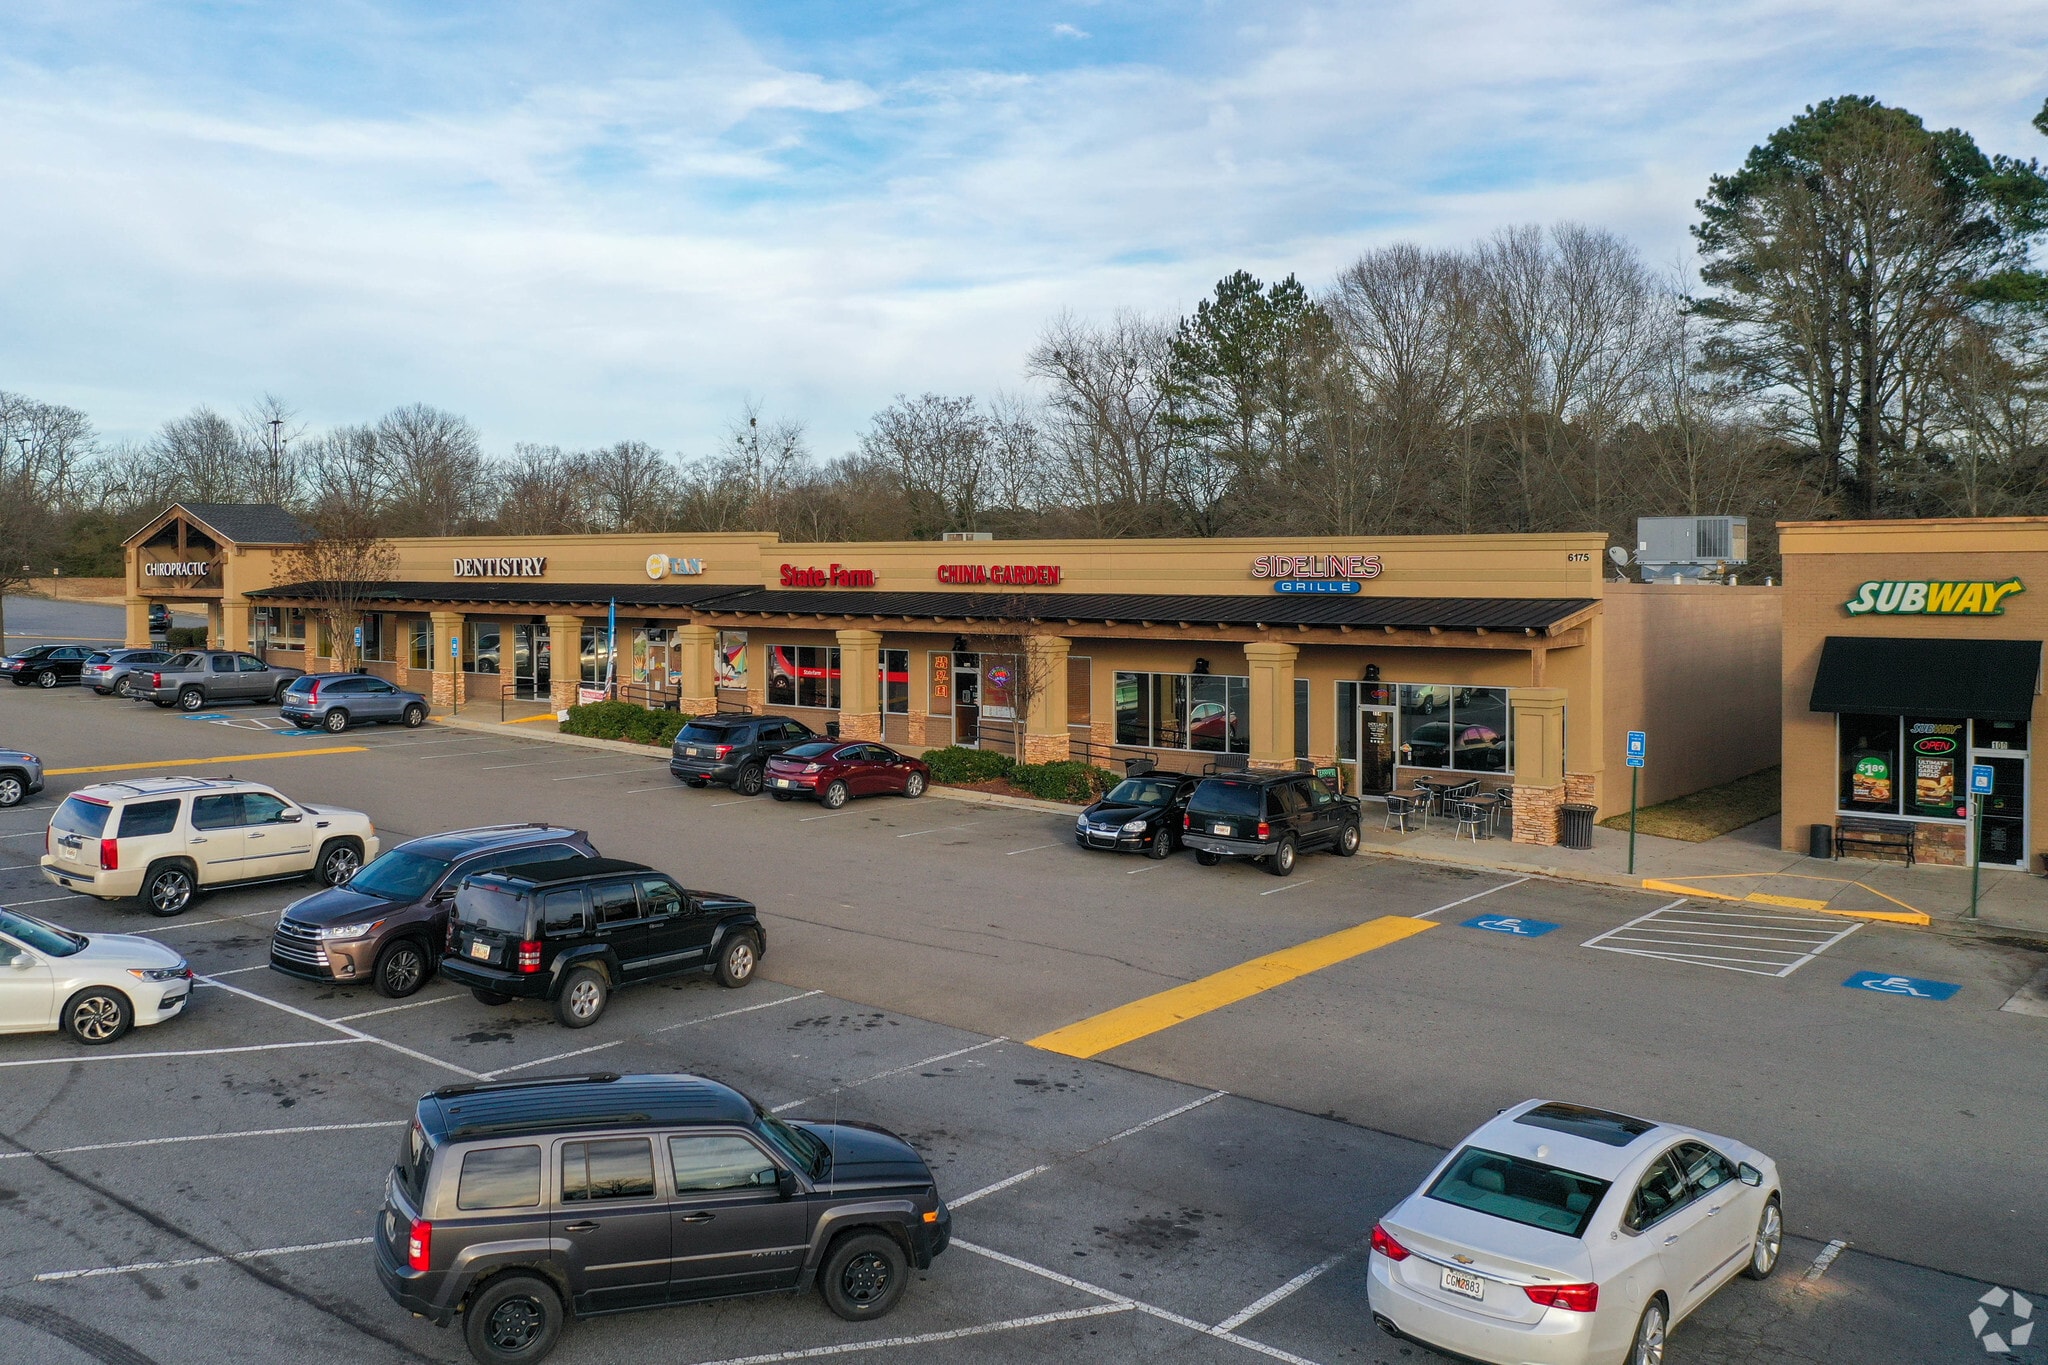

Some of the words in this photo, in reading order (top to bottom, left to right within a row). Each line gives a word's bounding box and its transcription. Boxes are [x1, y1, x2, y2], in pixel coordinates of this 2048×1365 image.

[1568, 553, 1590, 562] 6175
[145, 561, 208, 576] CHIROPRACTIC
[453, 557, 544, 577] DENTISTRY
[669, 558, 703, 575] TAN
[1252, 555, 1382, 578] SIDELINES
[780, 563, 826, 587] State
[829, 563, 875, 586] Farm
[937, 565, 987, 584] CHINA
[990, 565, 1060, 585] GARDEN
[1281, 582, 1351, 592] GRILLE
[1847, 579, 2022, 613] SUBWAY
[1910, 723, 1962, 735] SUBWAY
[1919, 740, 1951, 751] OPEN
[751, 1249, 794, 1258] PATRIOT
